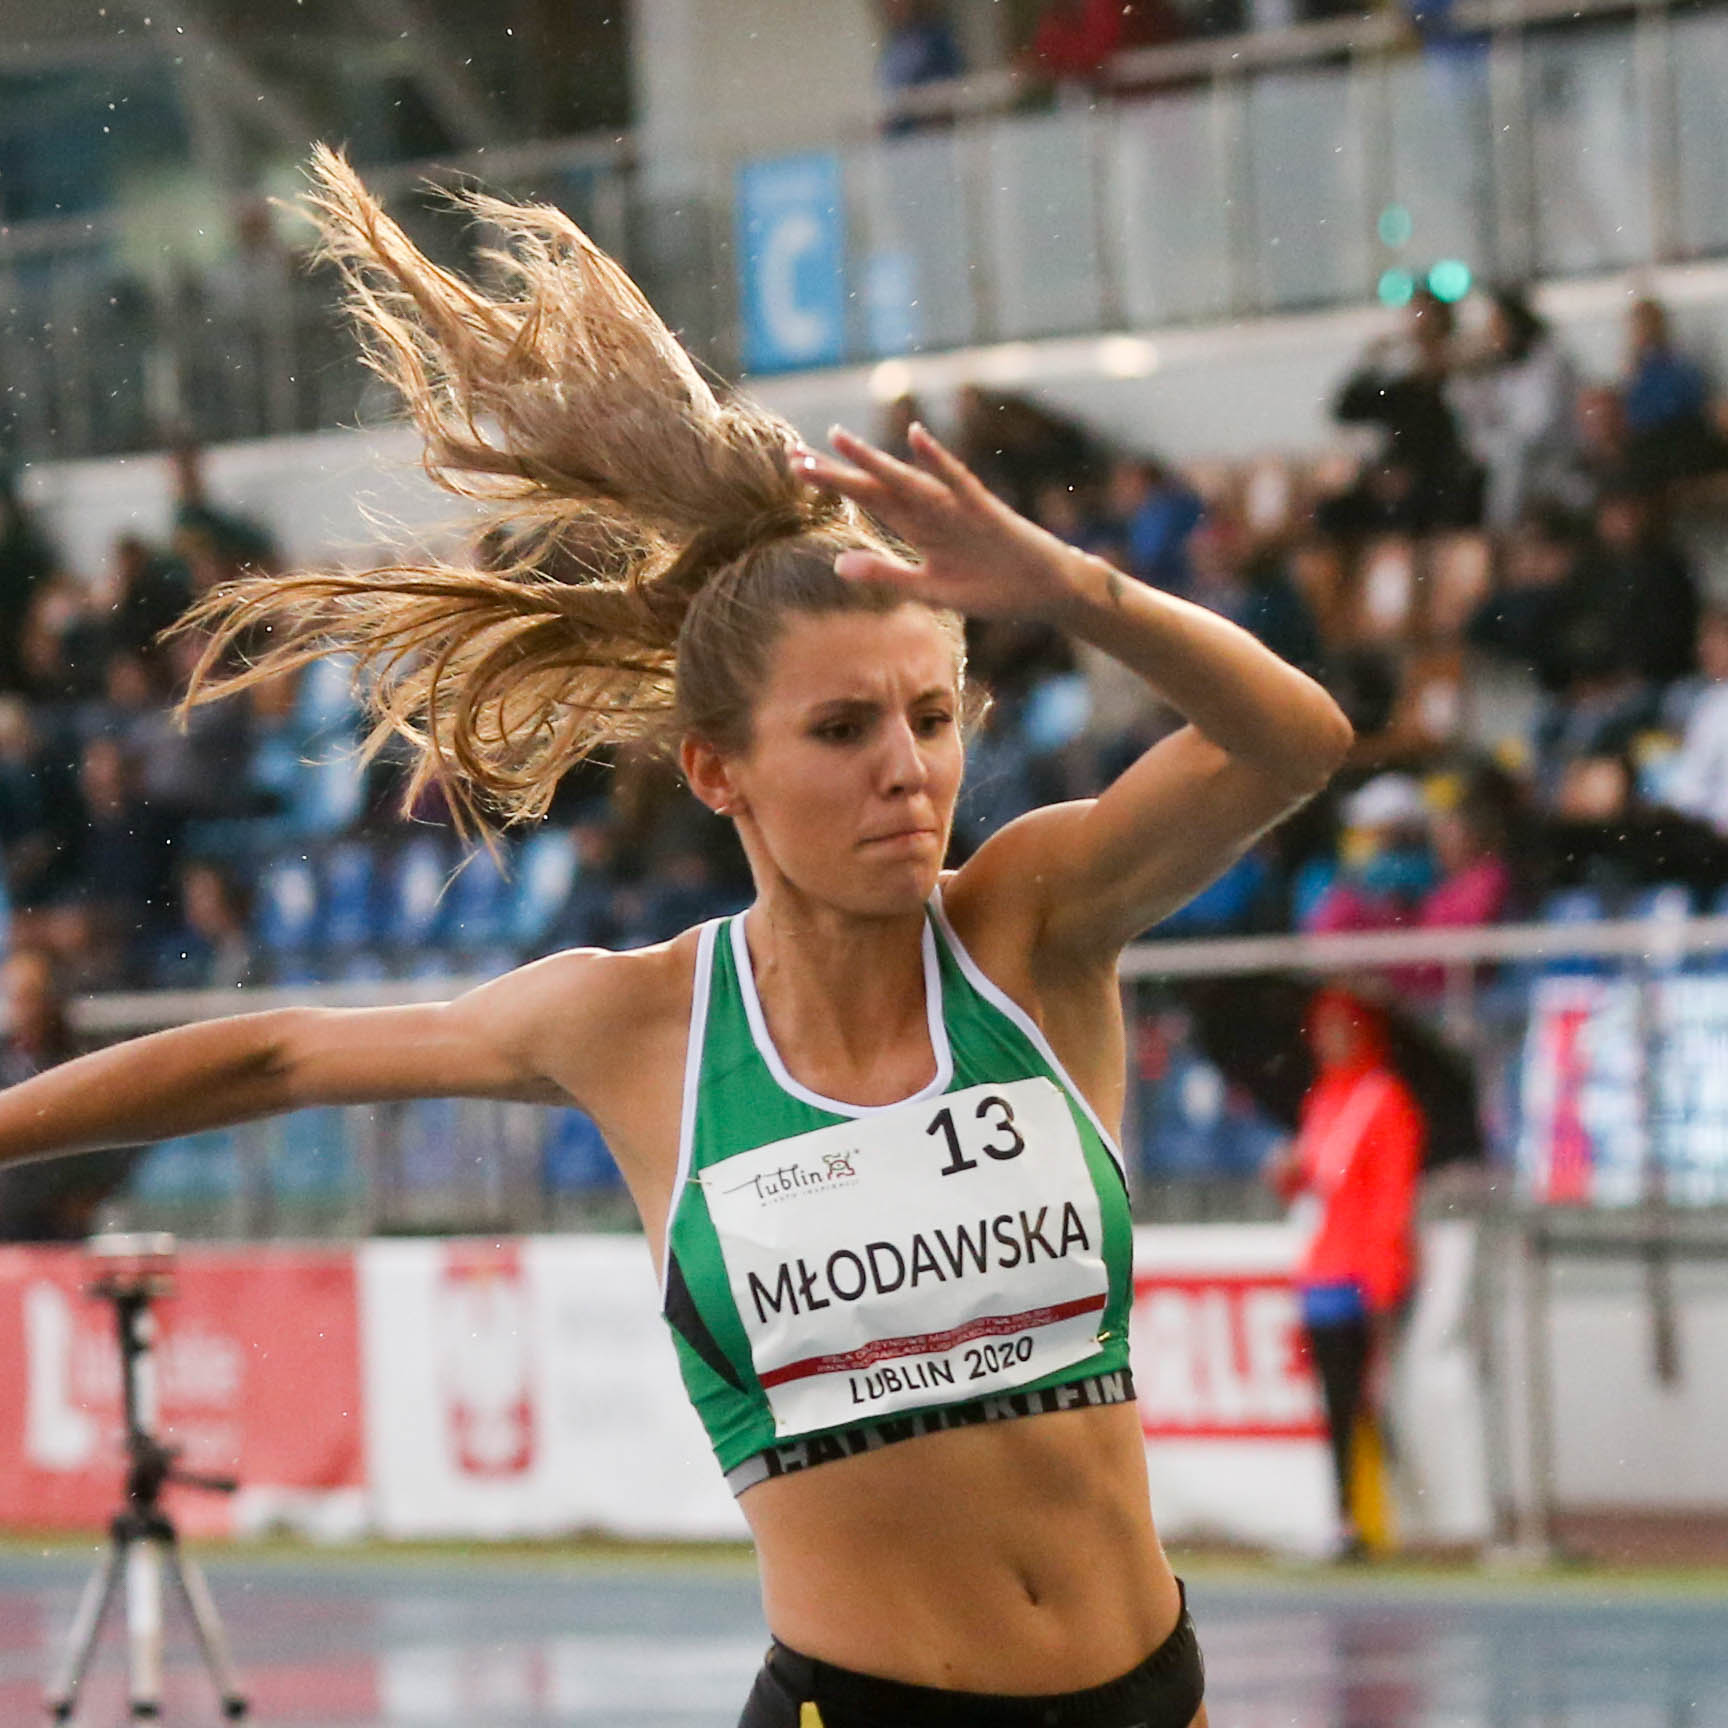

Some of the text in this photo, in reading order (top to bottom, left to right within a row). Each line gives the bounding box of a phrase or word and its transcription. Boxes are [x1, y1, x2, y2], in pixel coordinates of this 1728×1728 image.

[926, 1095, 1026, 1177] 13
[747, 1200, 1092, 1325] MŁODAWSKA
[849, 1358, 955, 1404] LUBLIN
[964, 1336, 1034, 1380] 2020
